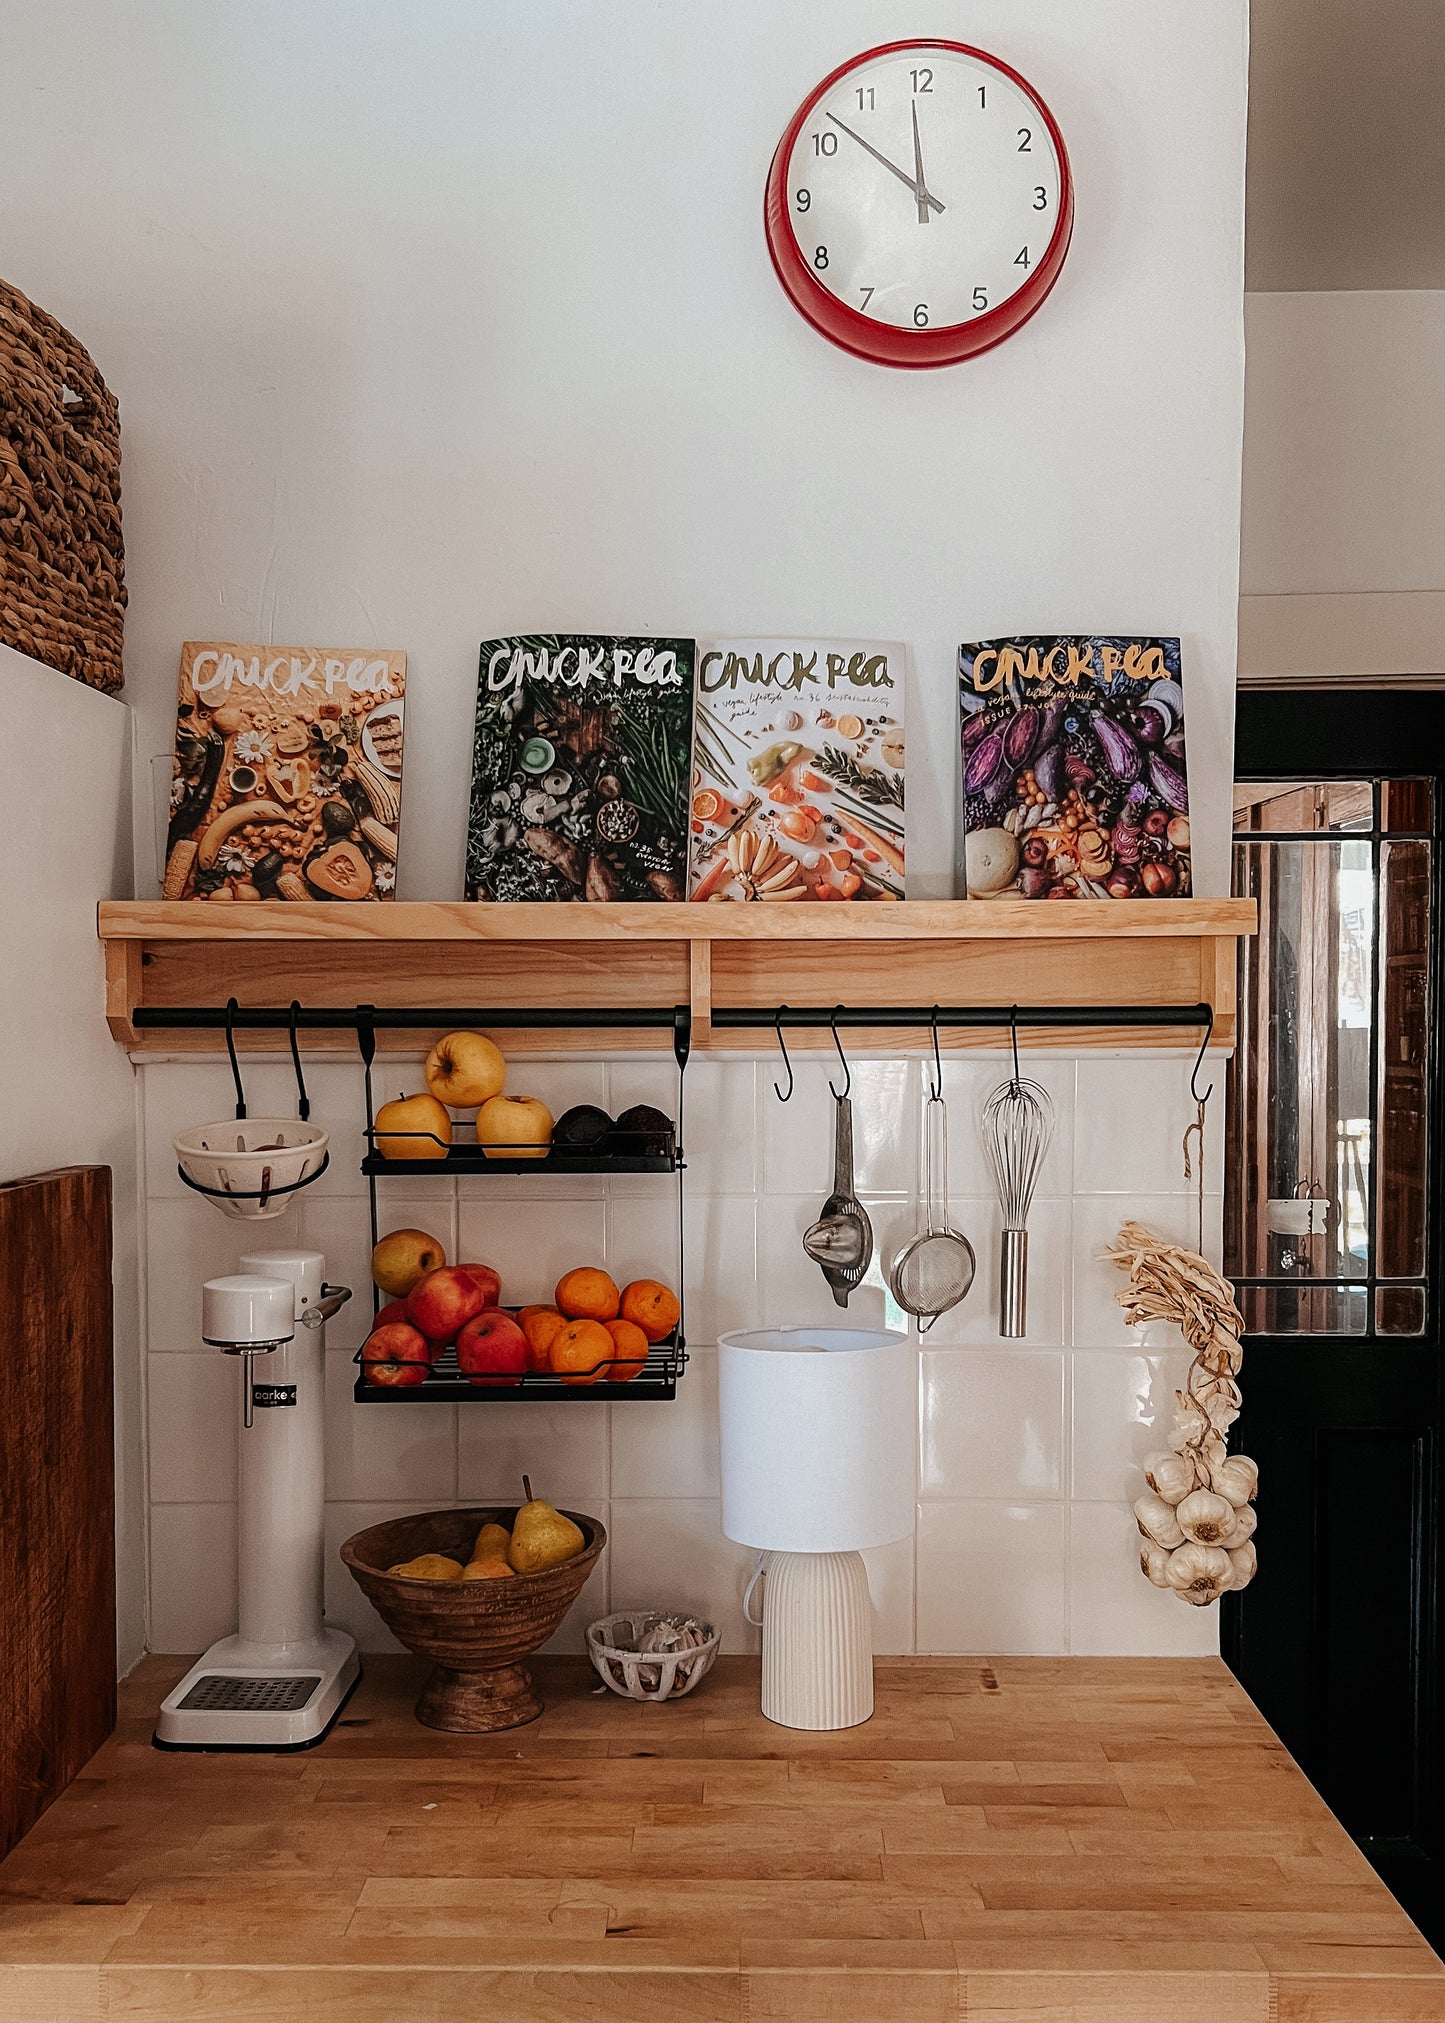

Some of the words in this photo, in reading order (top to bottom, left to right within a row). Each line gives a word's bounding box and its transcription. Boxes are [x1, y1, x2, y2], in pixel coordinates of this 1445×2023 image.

[909, 68, 933, 93] 12
[855, 87, 875, 111] 11
[977, 86, 986, 109] 1
[812, 132, 838, 156] 10
[1016, 128, 1032, 152] 2
[796, 188, 811, 213] 9
[1032, 186, 1047, 210] 3
[814, 246, 829, 269] 8
[1013, 246, 1031, 269] 4
[859, 287, 875, 311] 7
[972, 287, 988, 311] 5
[913, 303, 929, 327] 6
[749, 692, 784, 706] lifestyle
[1069, 688, 1096, 703] guide
[980, 706, 1012, 727] ISSUE
[254, 1389, 288, 1400] aarke
